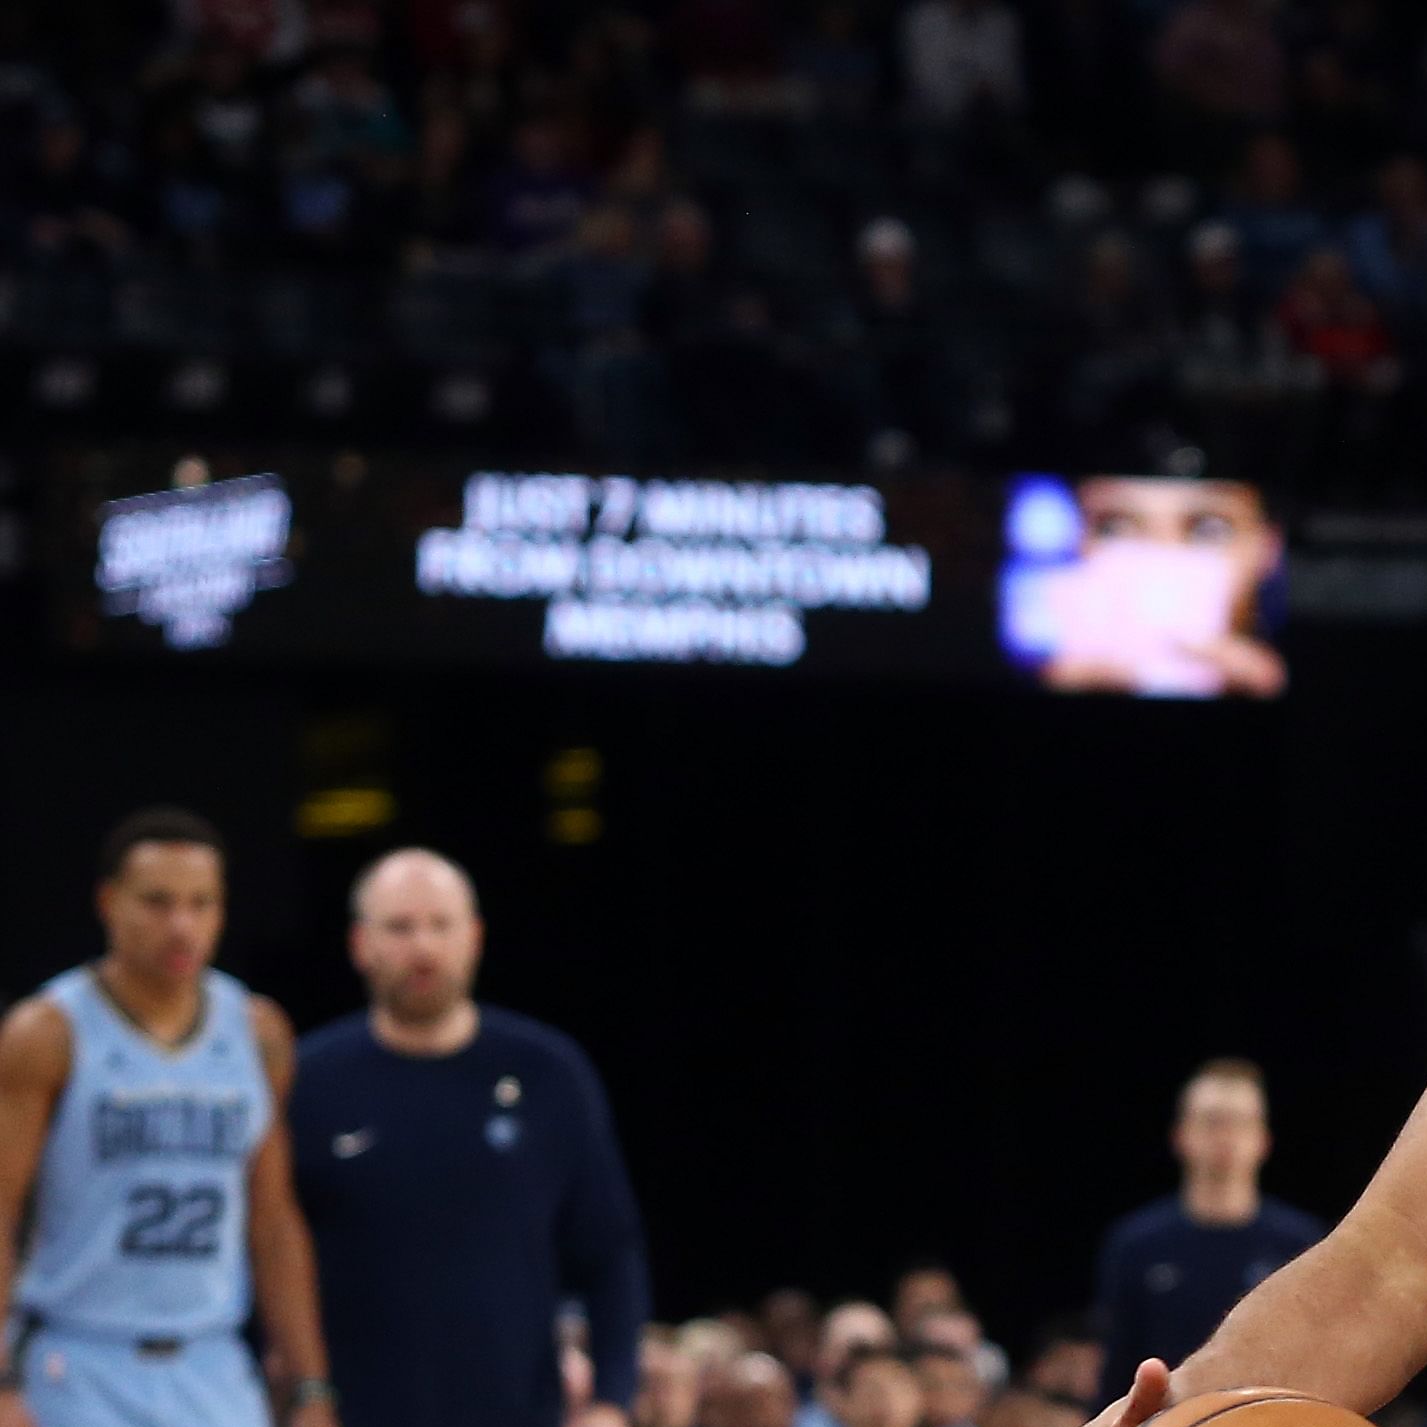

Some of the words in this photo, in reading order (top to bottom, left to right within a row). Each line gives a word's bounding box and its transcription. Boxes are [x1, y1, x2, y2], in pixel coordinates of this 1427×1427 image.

[417, 528, 582, 596] FROM
[586, 536, 930, 612] DOWNTOWN
[545, 599, 805, 665] MEMPHIS
[118, 1185, 227, 1260] 22
